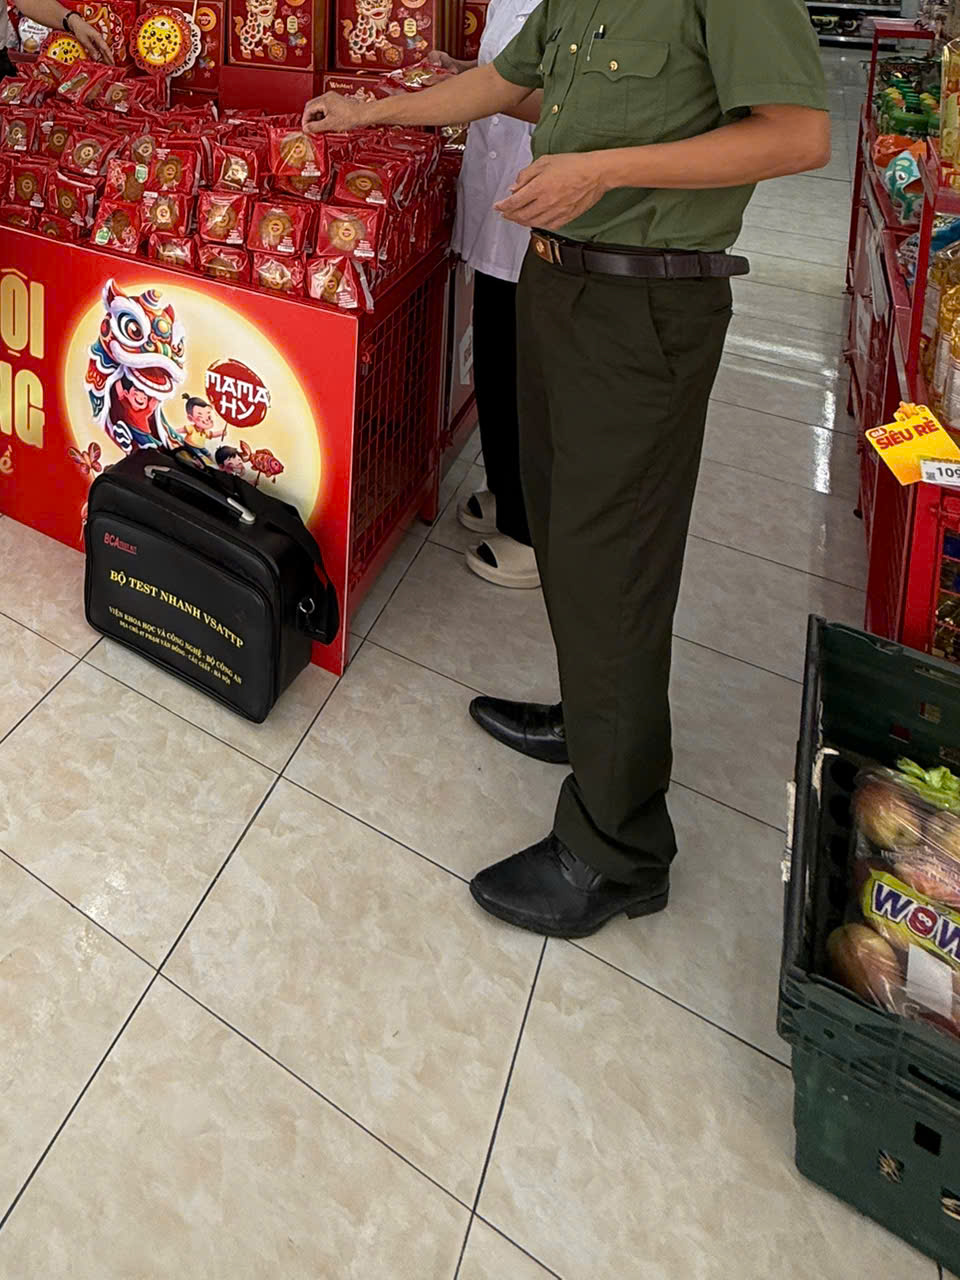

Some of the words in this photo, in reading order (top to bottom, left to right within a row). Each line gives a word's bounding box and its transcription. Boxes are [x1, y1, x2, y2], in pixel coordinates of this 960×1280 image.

[206, 371, 271, 408] MAMA
[220, 395, 255, 420] HY
[876, 428, 914, 450] SIÊU
[913, 417, 940, 437] RẺ
[110, 570, 127, 586] BỘ
[128, 578, 158, 597] TEST
[159, 590, 201, 619] NHANH
[203, 612, 244, 648] VSATTP
